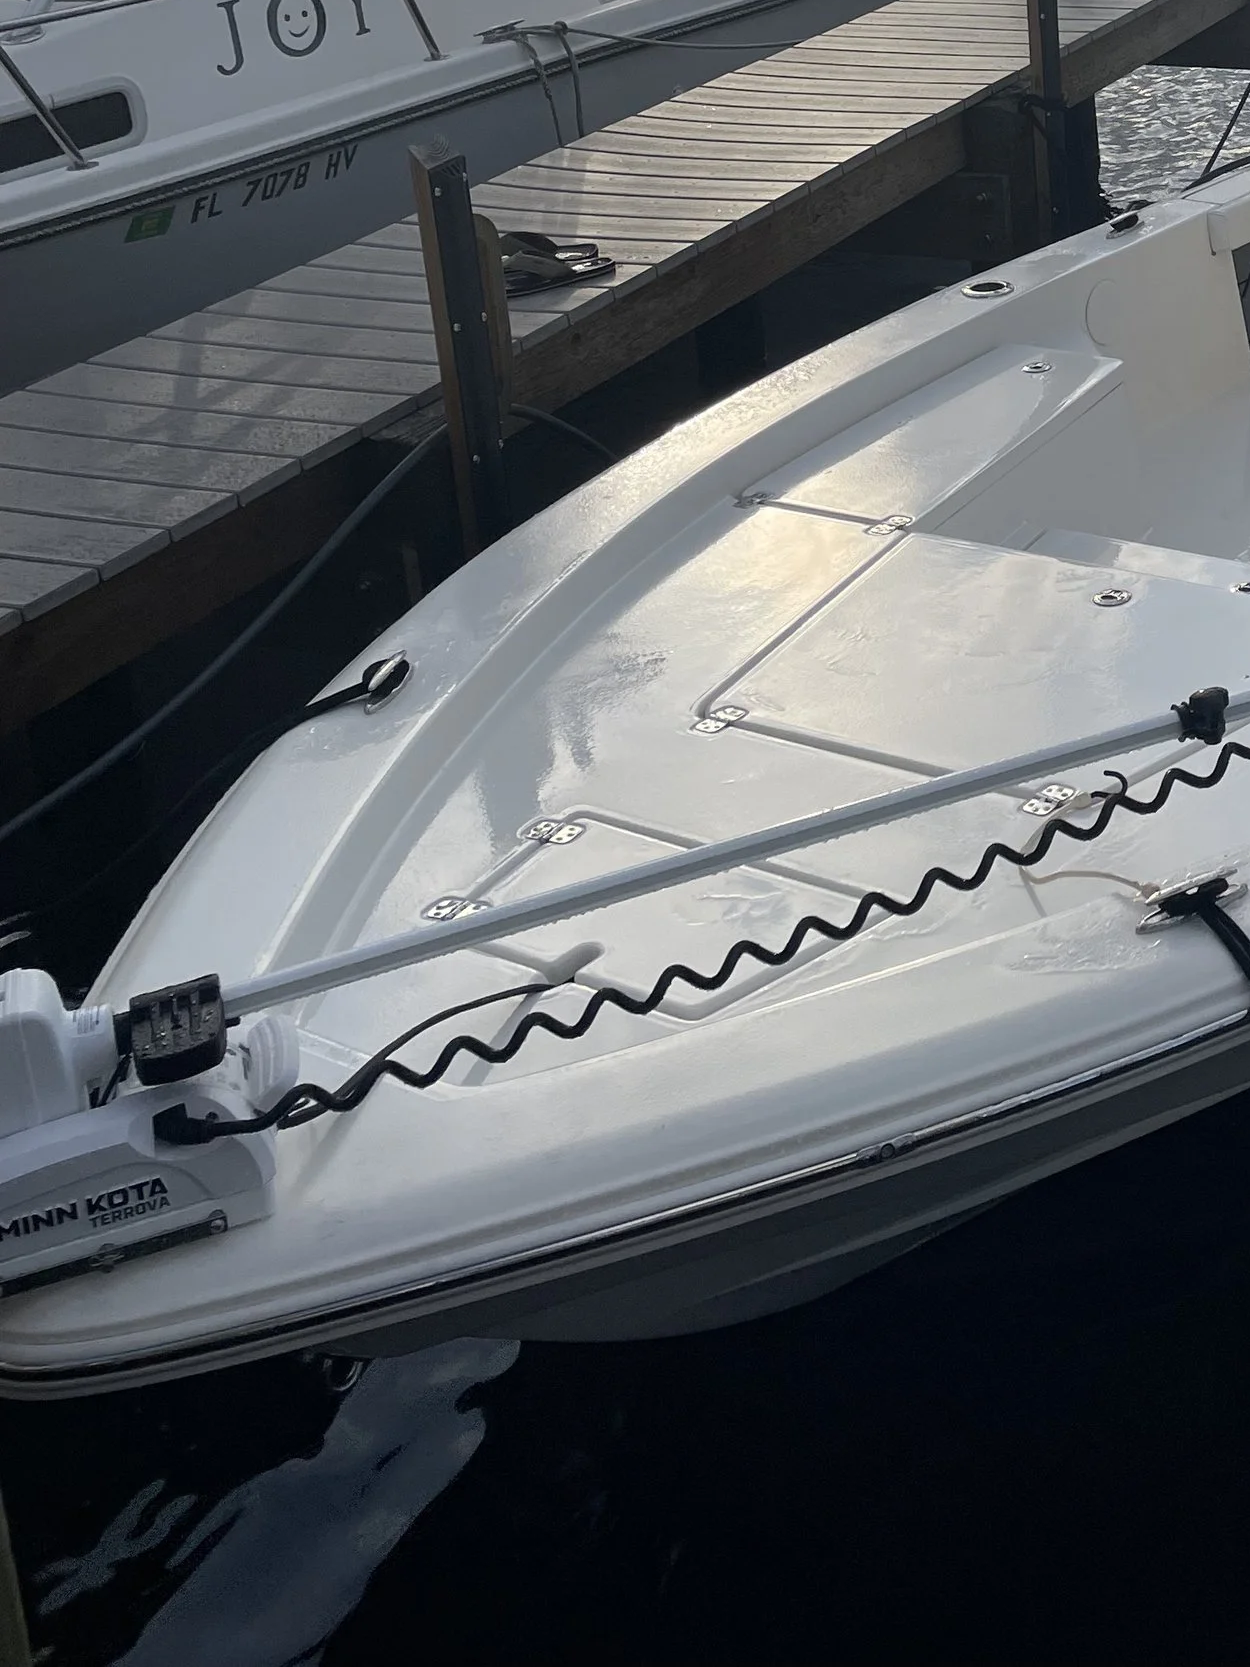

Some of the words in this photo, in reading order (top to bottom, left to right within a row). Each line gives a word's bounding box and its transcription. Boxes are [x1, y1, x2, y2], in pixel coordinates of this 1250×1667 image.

[190, 192, 223, 224] FL
[241, 161, 311, 207] 7078
[324, 144, 358, 180] HV
[0, 1201, 79, 1242] MINN
[86, 1177, 169, 1216] KOTA
[89, 1196, 171, 1228] TERROVA
